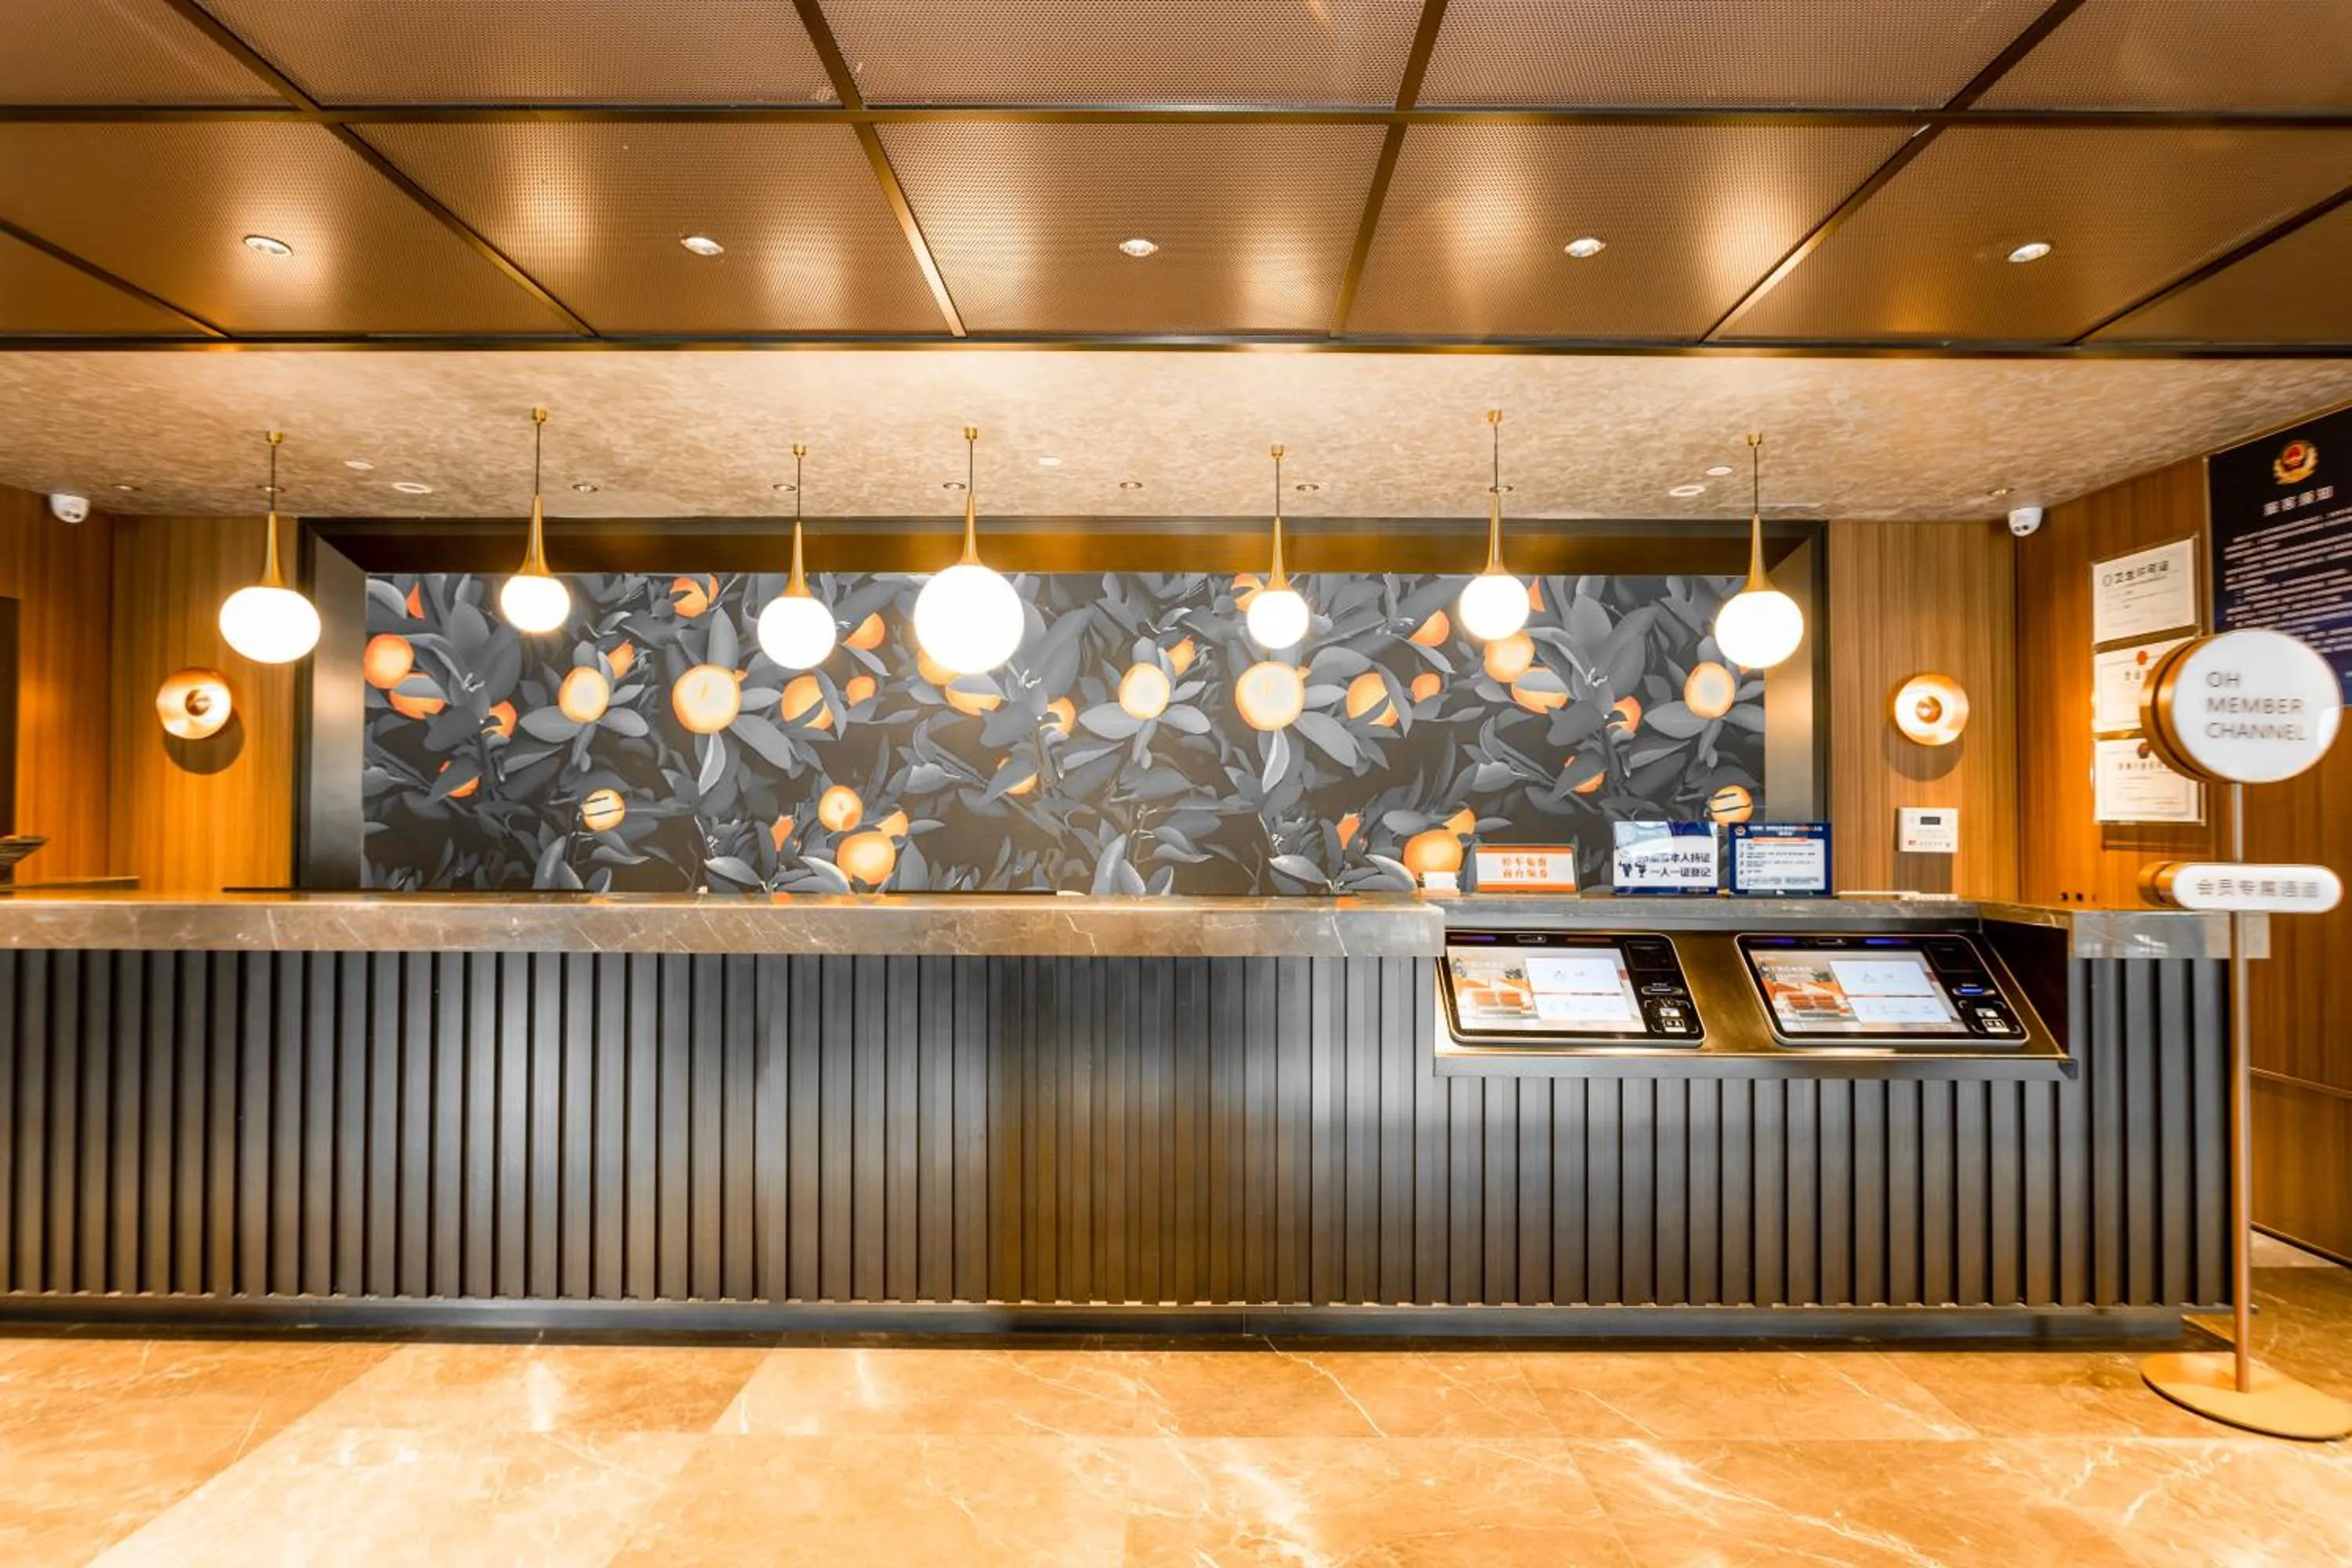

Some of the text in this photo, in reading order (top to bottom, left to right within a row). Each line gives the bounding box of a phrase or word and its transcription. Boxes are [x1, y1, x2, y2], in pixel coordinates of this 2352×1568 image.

[2206, 672, 2241, 688] OH
[2206, 697, 2303, 714] MEMBER
[2205, 722, 2307, 740] CHANNEL
[1650, 867, 1711, 877] 一人一证登记
[2196, 879, 2319, 898] 会员专属通道
